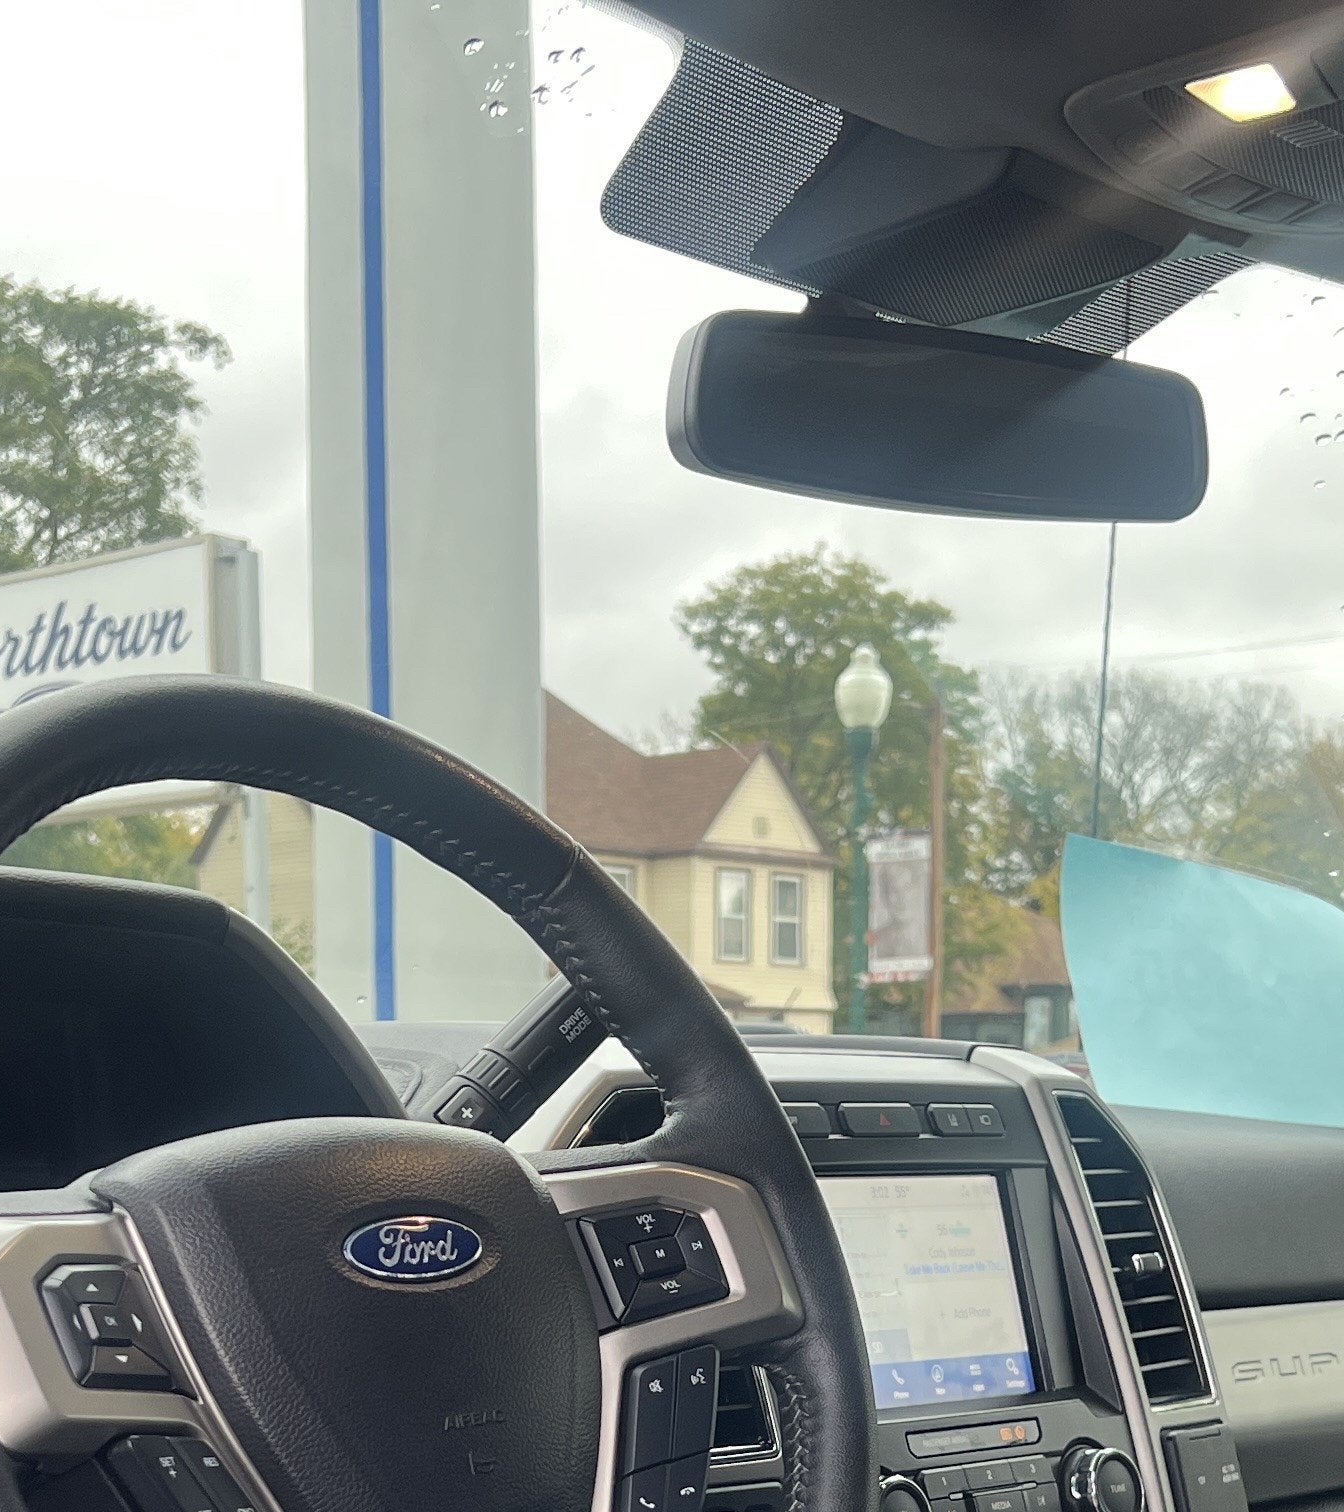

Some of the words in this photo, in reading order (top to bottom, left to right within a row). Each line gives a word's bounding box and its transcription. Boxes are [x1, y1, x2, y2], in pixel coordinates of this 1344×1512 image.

[558, 1006, 587, 1035] DRIVE
[565, 1017, 593, 1044] MODE
[635, 1214, 656, 1225] VOL
[377, 1226, 458, 1268] Ford
[655, 1249, 666, 1259] M
[660, 1280, 681, 1291] VOL
[159, 1455, 176, 1469] SET
[203, 1456, 220, 1468] RES
[991, 1500, 1012, 1511] MEDIA
